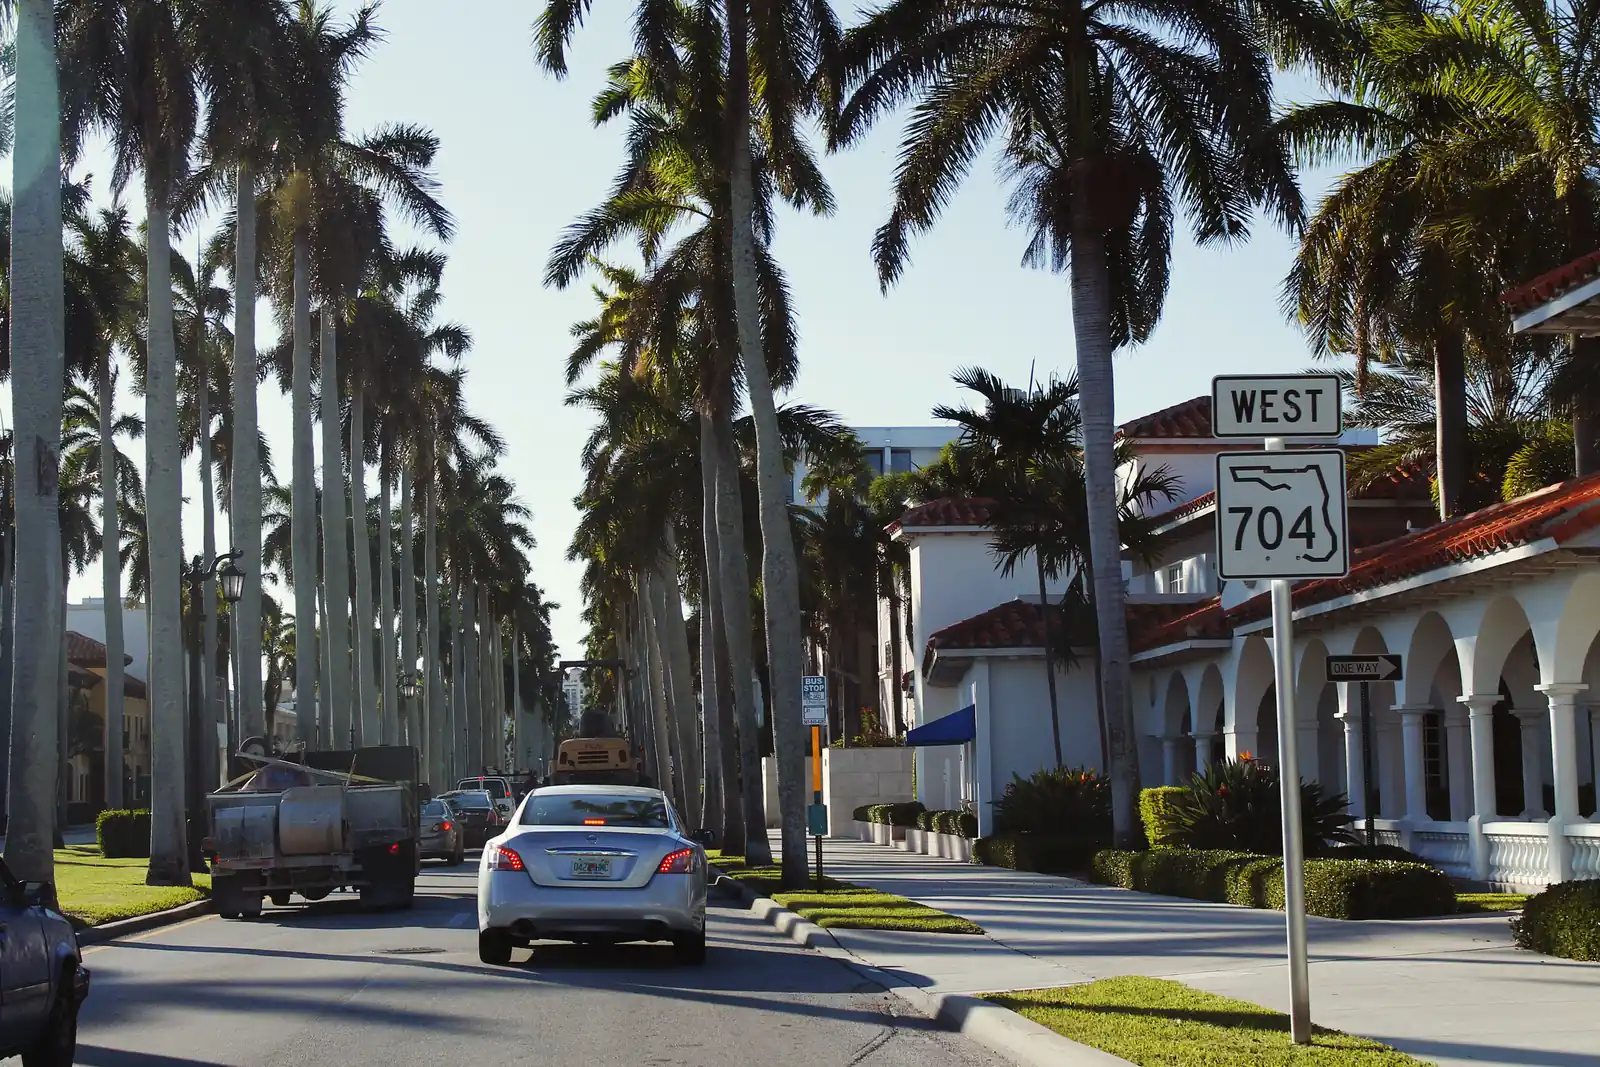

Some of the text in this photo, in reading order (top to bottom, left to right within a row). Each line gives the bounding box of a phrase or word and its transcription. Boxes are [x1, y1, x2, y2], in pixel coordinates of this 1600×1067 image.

[1230, 388, 1323, 424] WEST
[1227, 505, 1316, 551] 704
[1334, 662, 1379, 673] ONE WAY
